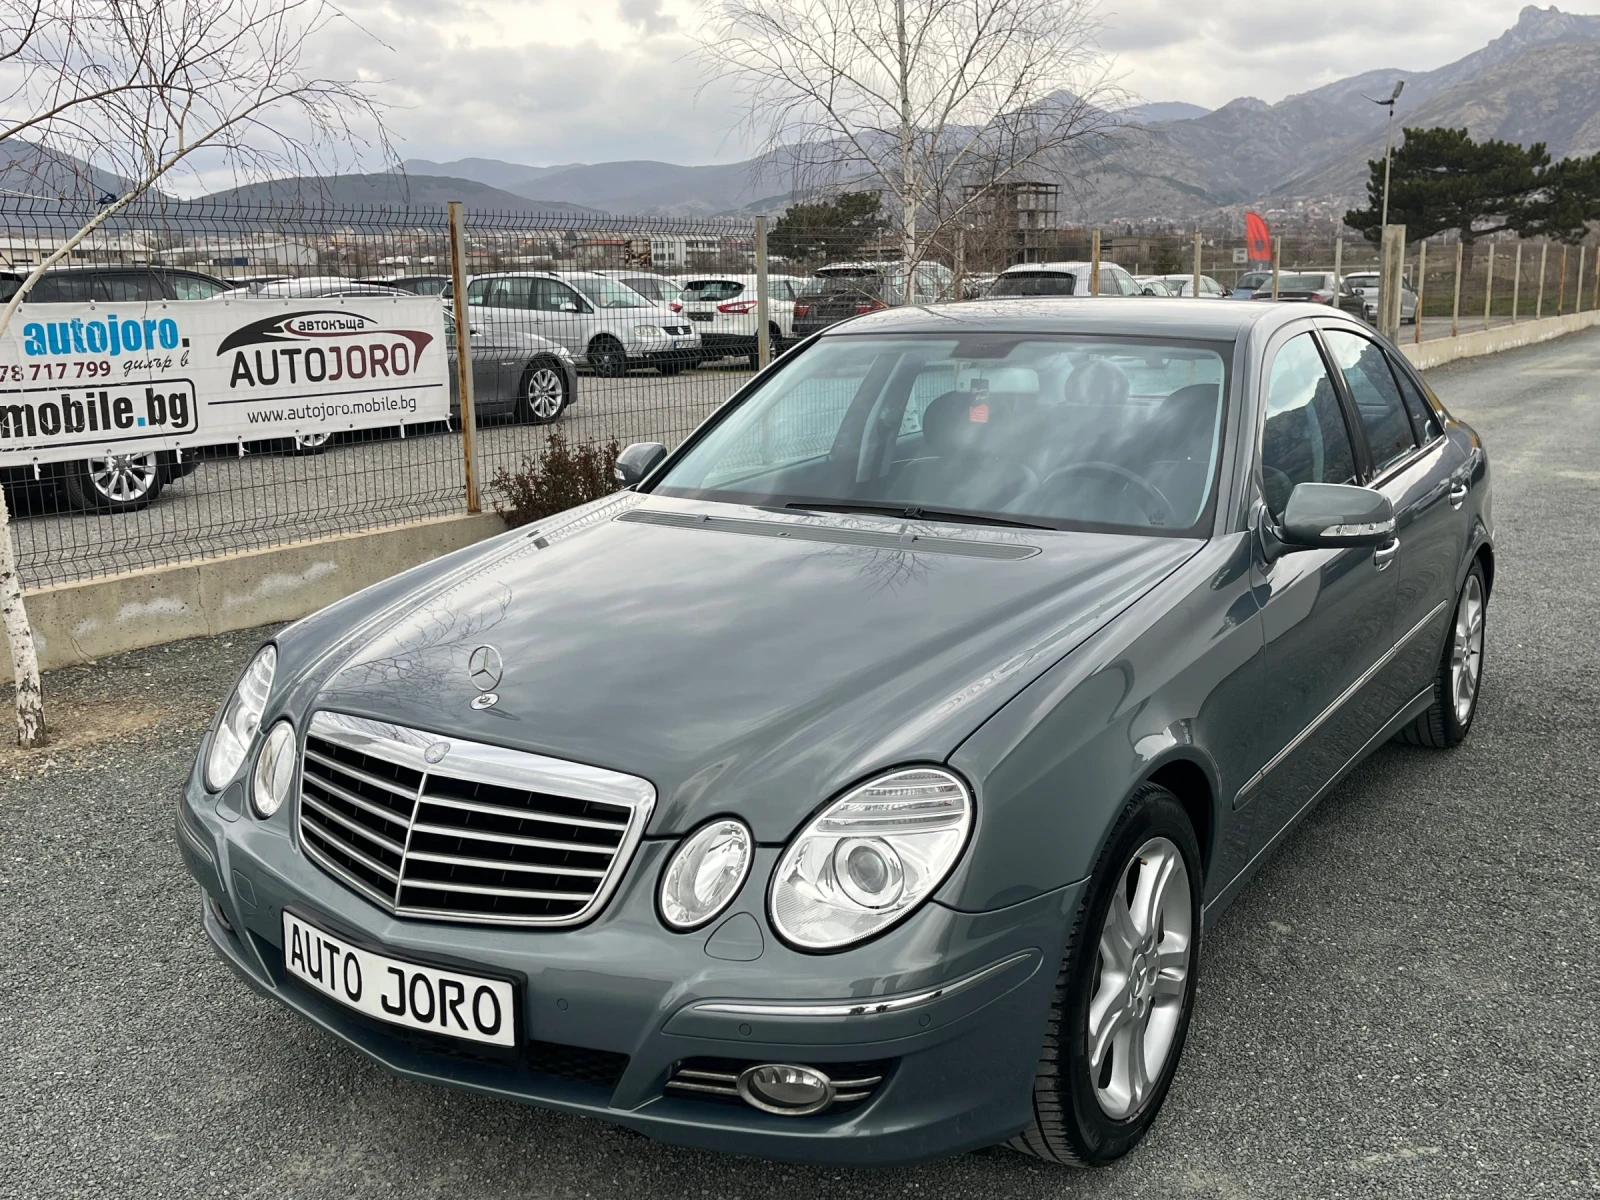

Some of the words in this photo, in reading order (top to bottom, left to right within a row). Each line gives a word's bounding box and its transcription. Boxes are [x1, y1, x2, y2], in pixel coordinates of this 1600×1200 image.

[298, 318, 365, 331] автокъща
[29, 363, 67, 381] 717
[73, 360, 111, 378] 799
[230, 343, 410, 388] AUTOJORO
[0, 388, 189, 438] mobile.bg
[247, 395, 417, 424] www.autojoro.mobile.bg
[291, 923, 363, 1003] AUTO
[381, 966, 502, 1036] JORO
